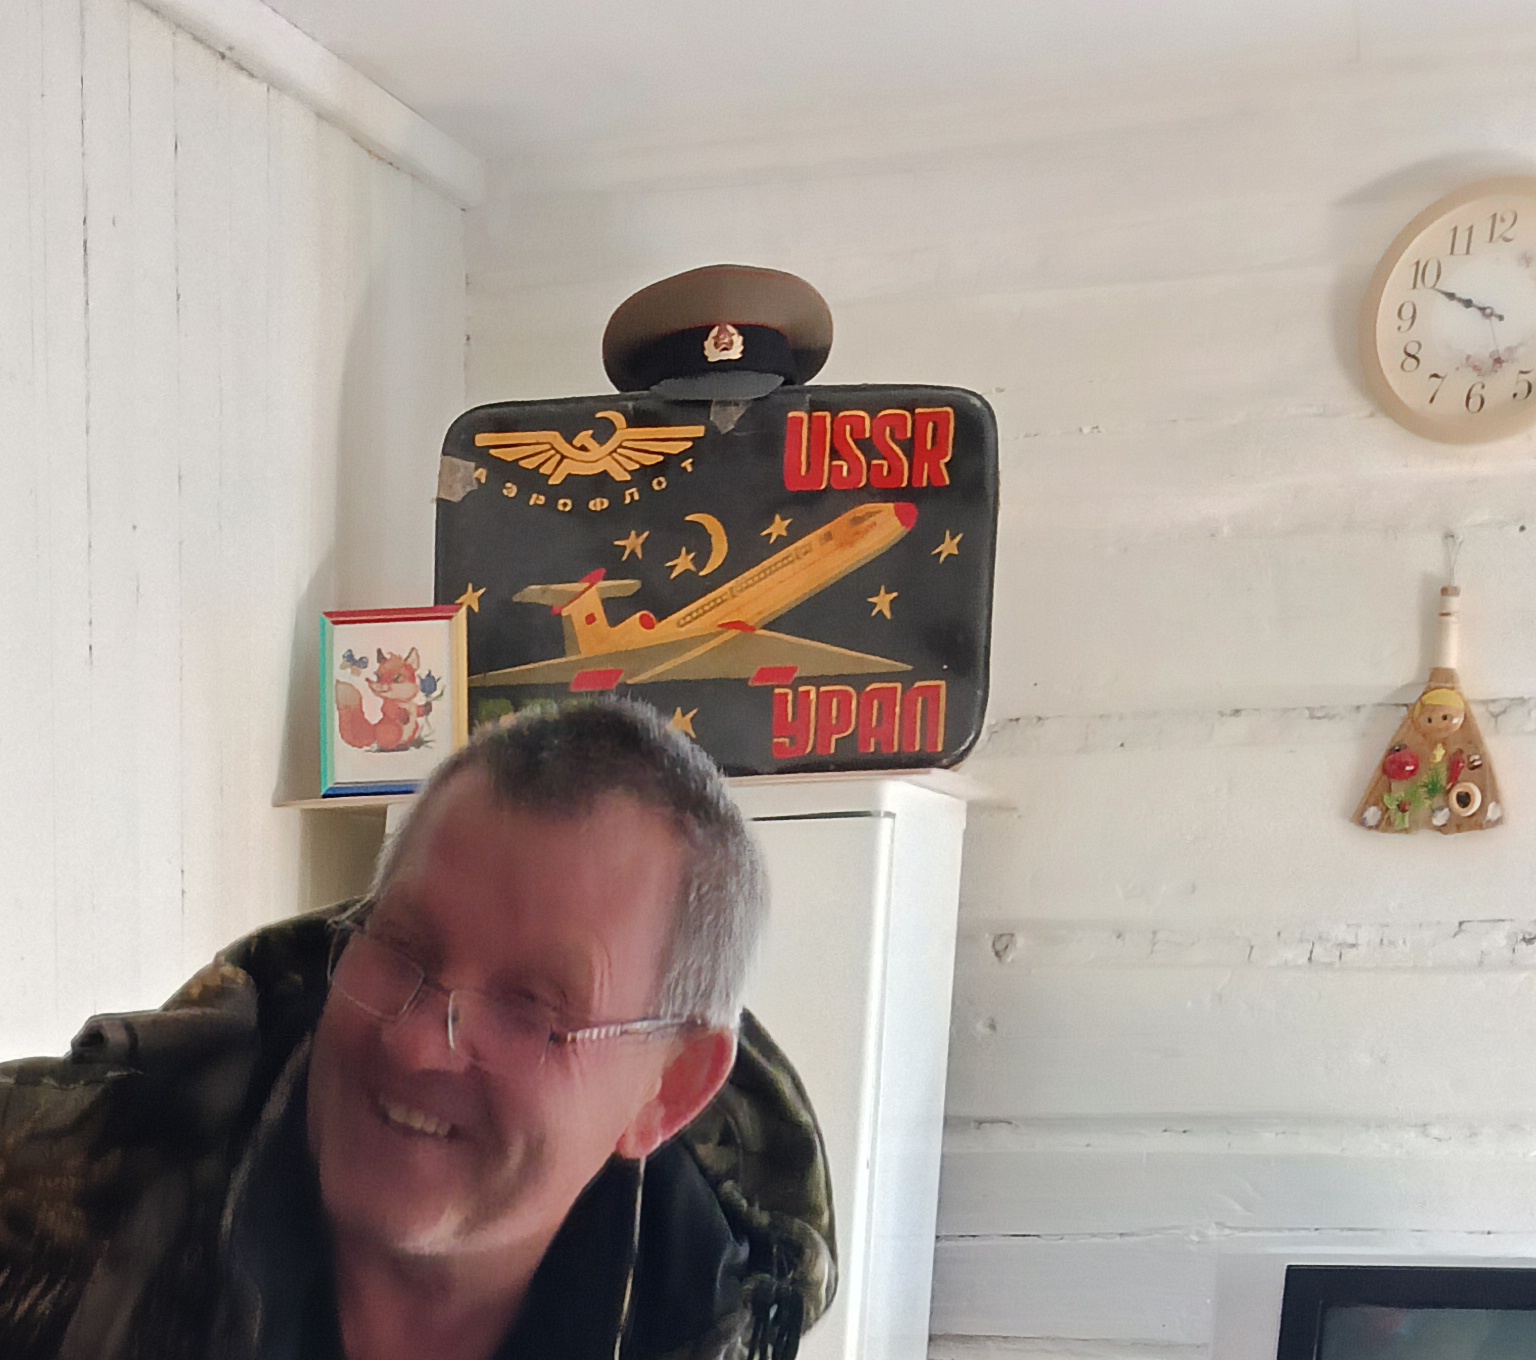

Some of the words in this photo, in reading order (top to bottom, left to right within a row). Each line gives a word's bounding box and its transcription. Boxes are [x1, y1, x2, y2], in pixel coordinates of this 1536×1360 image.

[1448, 224, 1475, 256] 11
[1486, 209, 1518, 244] 12
[1410, 257, 1443, 290] 10
[1396, 300, 1418, 333] 9
[1399, 340, 1423, 373] 8
[1427, 372, 1448, 405] 7
[1464, 381, 1486, 414] 6
[1512, 369, 1534, 401] 5
[783, 406, 955, 492] USSR
[473, 457, 694, 512] АЭРОФЛОТ
[772, 679, 947, 760] УРАЛ
